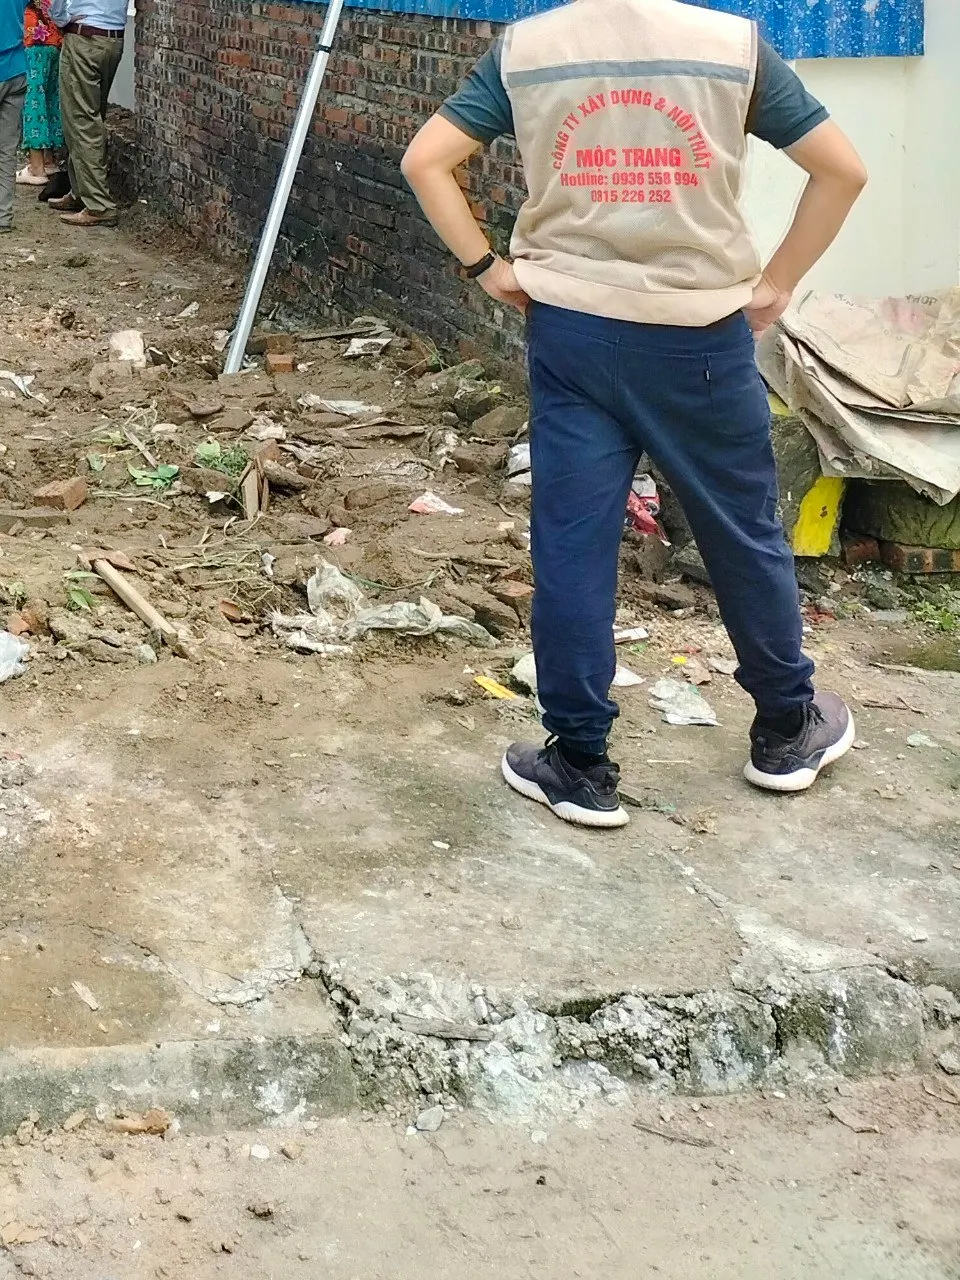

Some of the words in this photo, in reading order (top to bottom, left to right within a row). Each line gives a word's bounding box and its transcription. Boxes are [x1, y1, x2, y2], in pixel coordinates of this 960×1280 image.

[551, 131, 570, 170] CÔNG
[562, 112, 581, 131] TY
[577, 93, 606, 118] XÂY
[610, 89, 652, 107] DỰNG
[654, 97, 666, 112] &
[667, 106, 696, 133] NỘI
[687, 132, 714, 170] THẤT
[576, 145, 617, 172] MỘC
[622, 148, 681, 168] TRANG
[560, 172, 608, 186] Hotline:
[674, 172, 699, 187] 994
[591, 190, 618, 203] 0815
[621, 190, 645, 203] 226
[648, 190, 672, 203] 252
